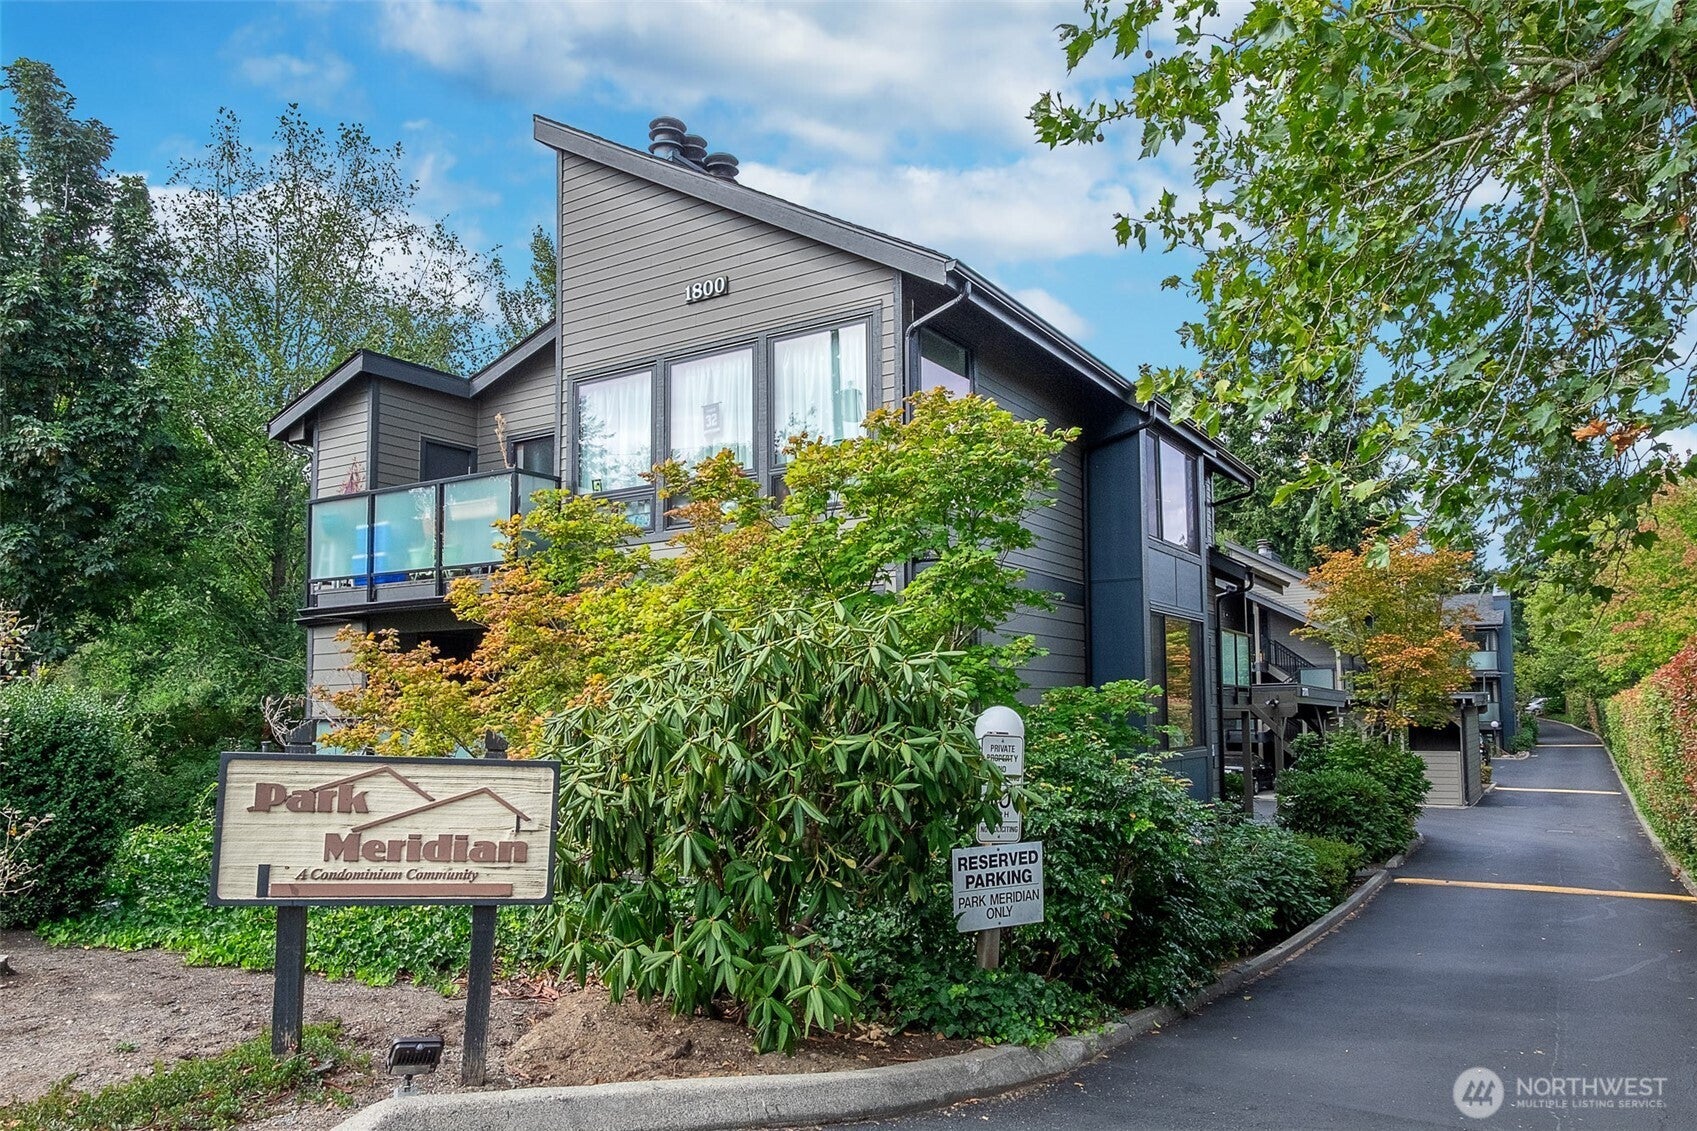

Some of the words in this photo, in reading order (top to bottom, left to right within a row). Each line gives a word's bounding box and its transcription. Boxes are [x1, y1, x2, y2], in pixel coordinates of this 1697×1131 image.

[685, 276, 725, 300] 1800
[986, 753, 1018, 762] PROPERTY
[990, 744, 1016, 752] PRIVATE
[246, 782, 369, 813] Park
[323, 832, 529, 863] Meridian
[957, 850, 1039, 871] RESERVED
[295, 868, 308, 880] A
[310, 868, 402, 880] Condominium
[405, 868, 479, 883] Community
[965, 868, 1033, 889] PARKING
[958, 894, 986, 909] PARK
[990, 889, 1040, 905] MERIDIAN
[986, 905, 1013, 919] ONLY
